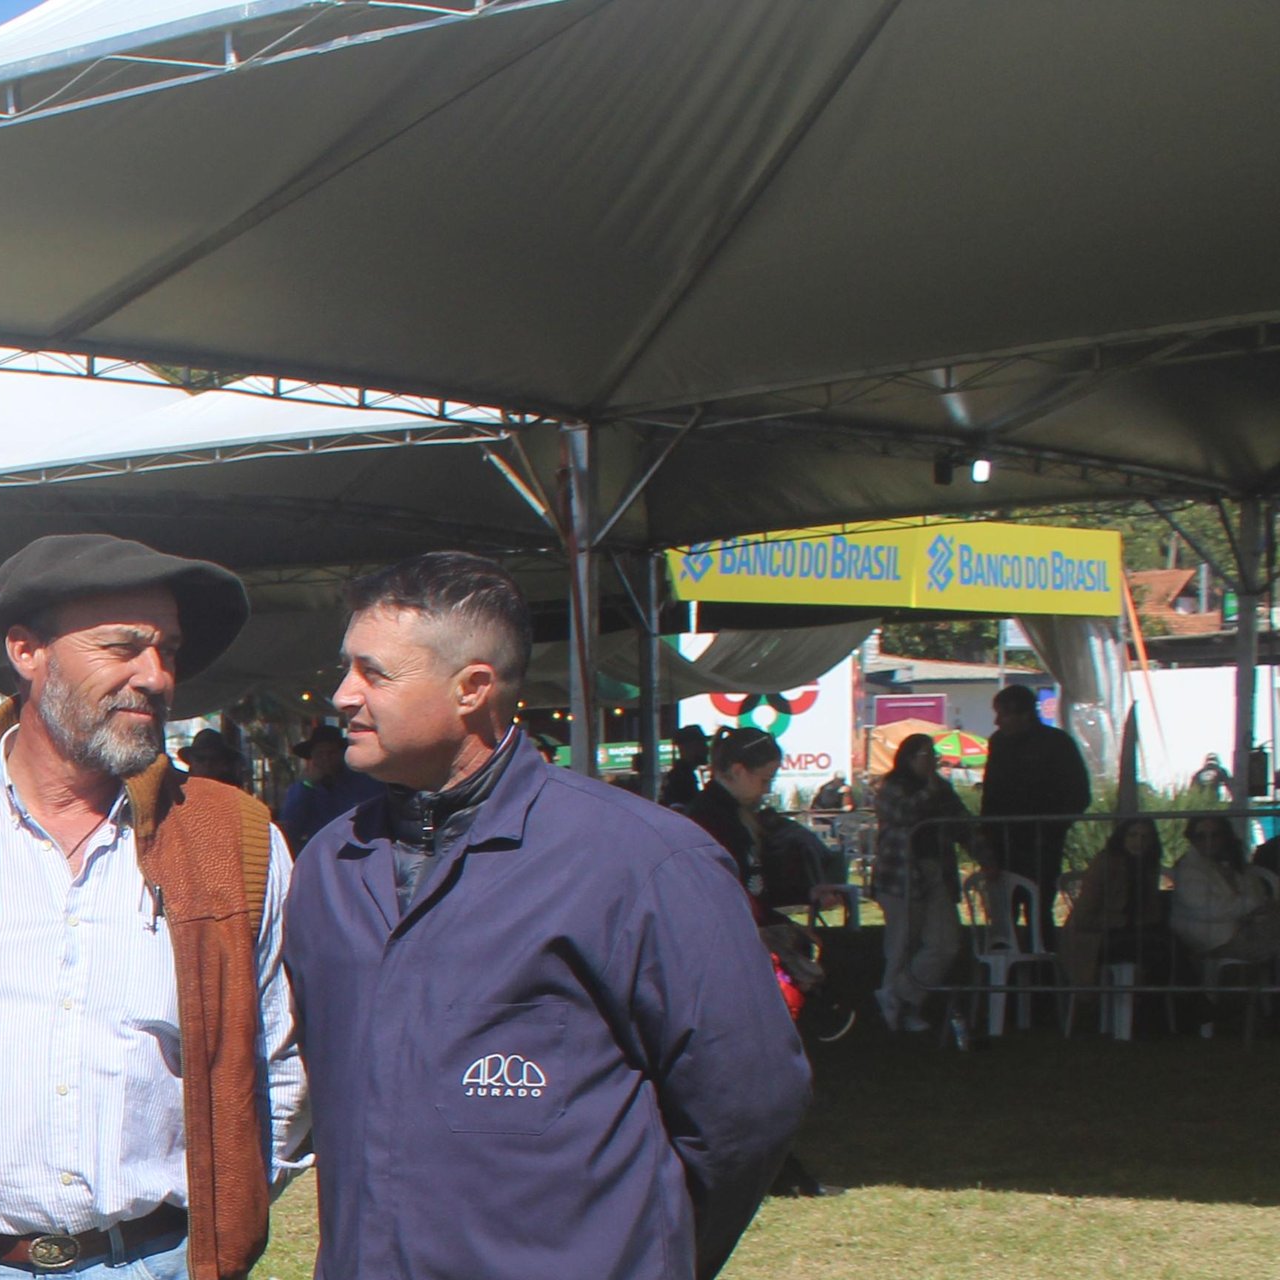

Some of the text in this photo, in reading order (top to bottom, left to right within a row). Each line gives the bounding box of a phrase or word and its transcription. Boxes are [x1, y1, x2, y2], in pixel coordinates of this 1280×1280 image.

[719, 534, 901, 581] BANCO DO BRASIL
[959, 544, 1111, 592] BANCO DO BRASIL
[465, 1087, 542, 1098] JURADO
